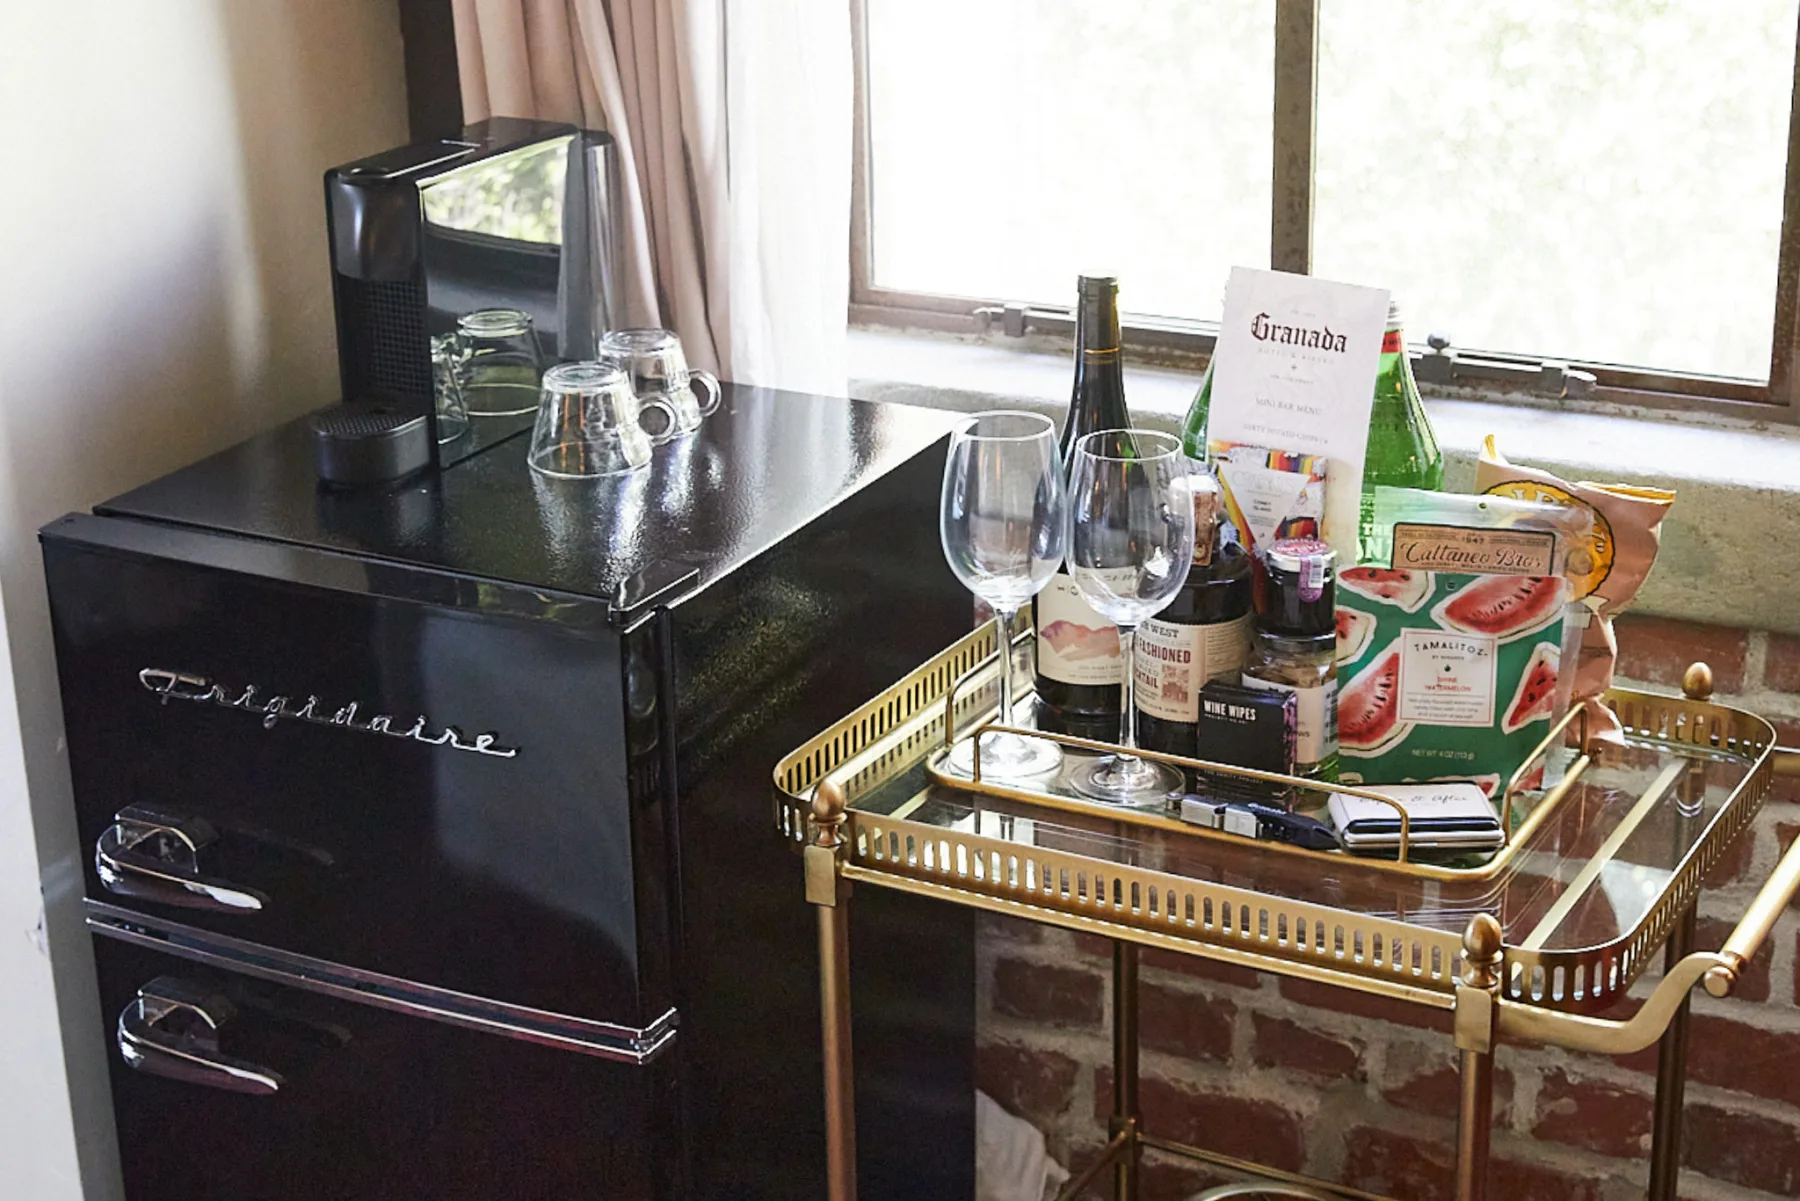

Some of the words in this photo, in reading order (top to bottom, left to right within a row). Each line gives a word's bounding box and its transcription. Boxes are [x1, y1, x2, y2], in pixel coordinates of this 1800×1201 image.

[1251, 312, 1347, 353] Granada
[1255, 397, 1276, 408] MINI
[1277, 400, 1294, 411] BAR
[1297, 404, 1323, 416] MENU
[1400, 541, 1491, 564] Cattaneo
[1150, 623, 1180, 639] WEST
[139, 667, 517, 758] Frigidaire
[1203, 699, 1227, 716] WINE
[1228, 705, 1256, 721] WIPES
